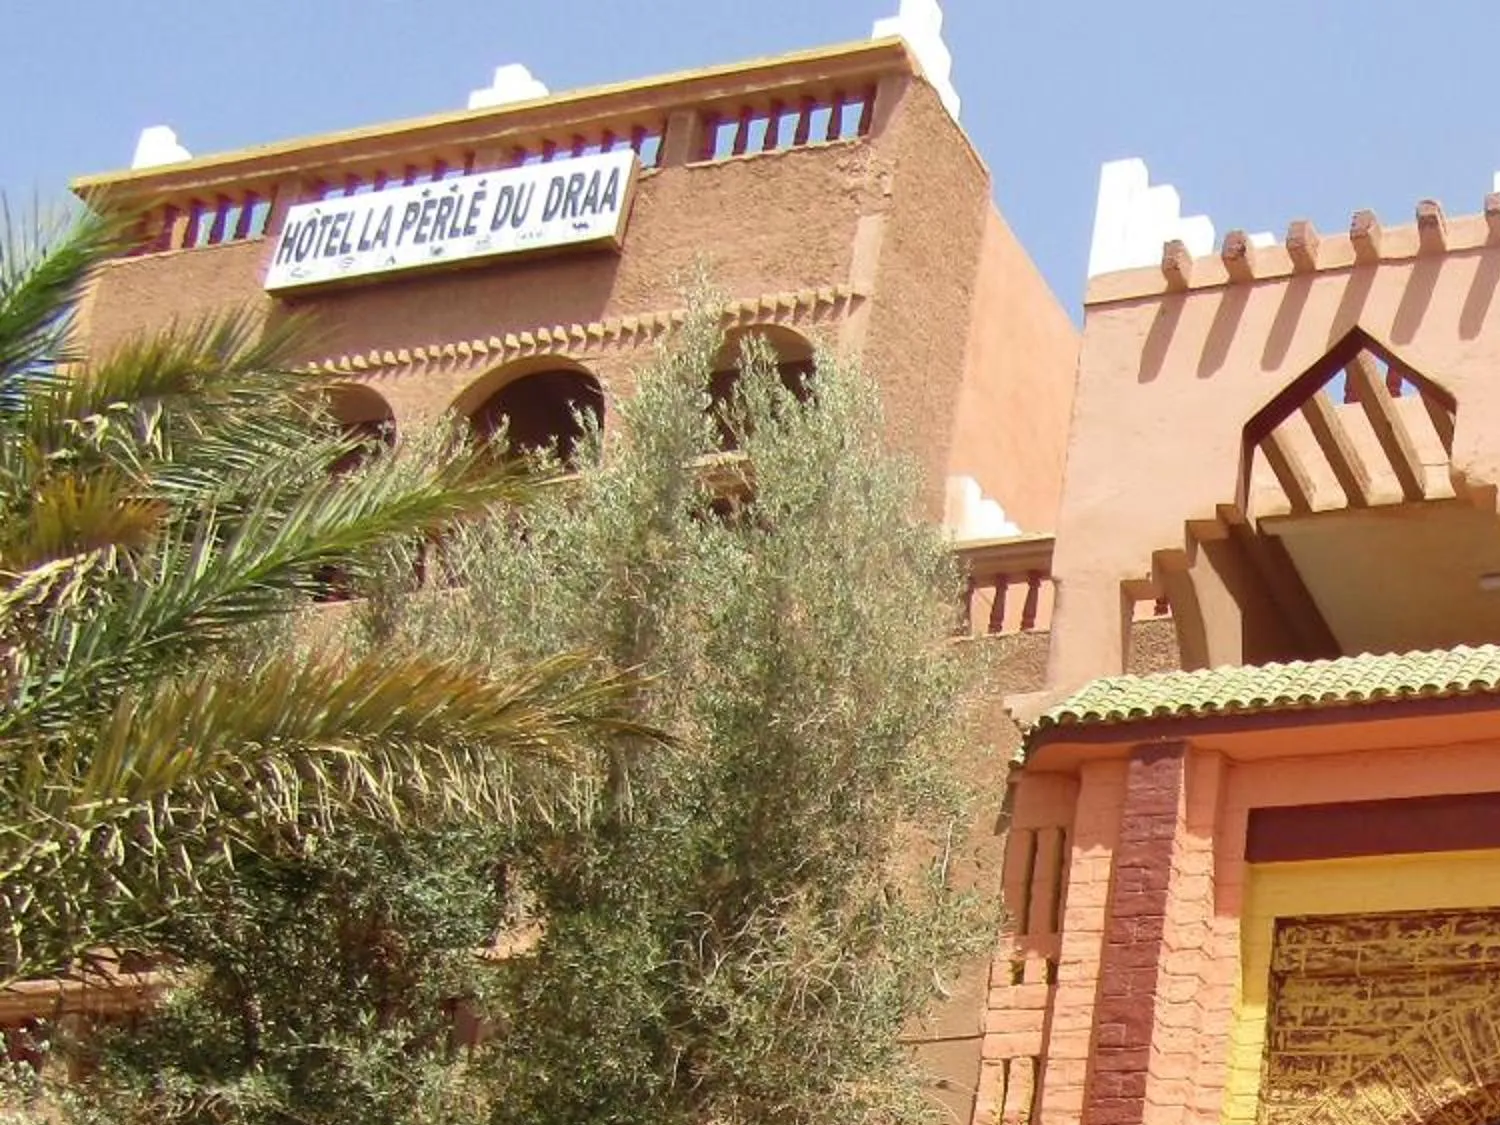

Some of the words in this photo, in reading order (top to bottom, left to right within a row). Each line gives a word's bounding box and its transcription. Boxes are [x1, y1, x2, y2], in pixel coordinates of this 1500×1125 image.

[357, 206, 393, 252] LA
[490, 182, 535, 231] DU
[542, 167, 619, 222] DRAA
